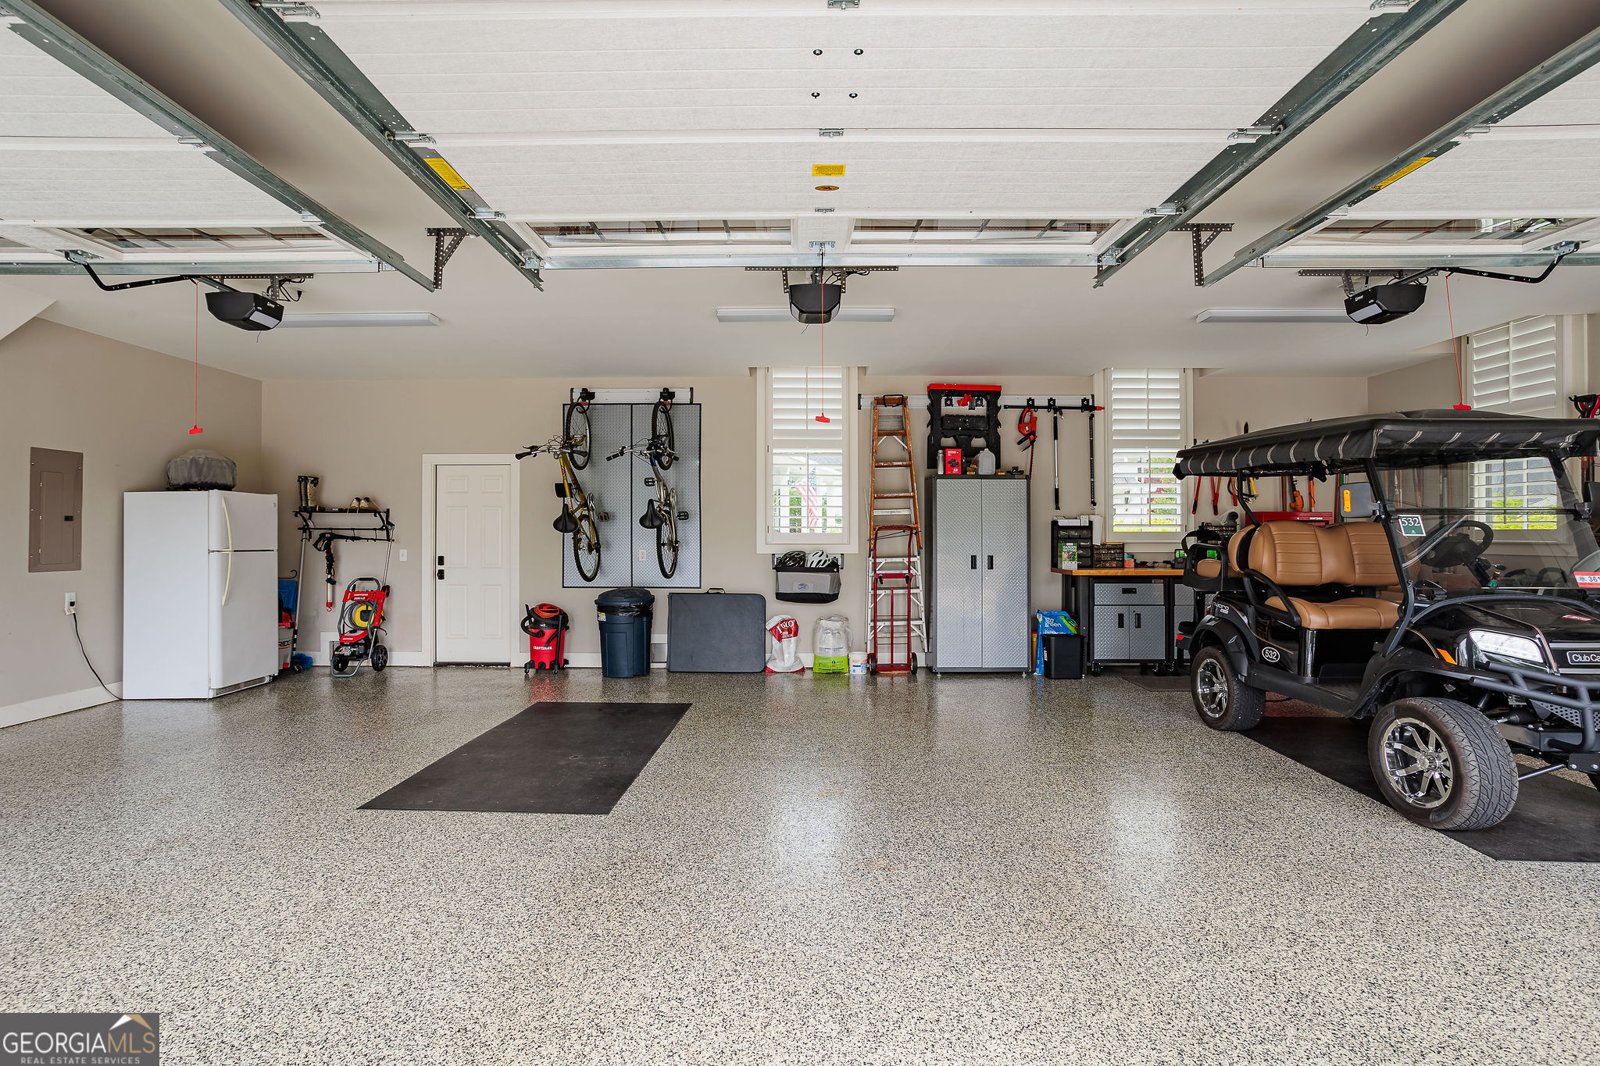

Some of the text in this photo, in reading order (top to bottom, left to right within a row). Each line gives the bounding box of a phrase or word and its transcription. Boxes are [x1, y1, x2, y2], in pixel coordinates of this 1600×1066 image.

[1401, 517, 1421, 527] 532
[1264, 649, 1278, 660] 532
[1572, 654, 1590, 662] Club
